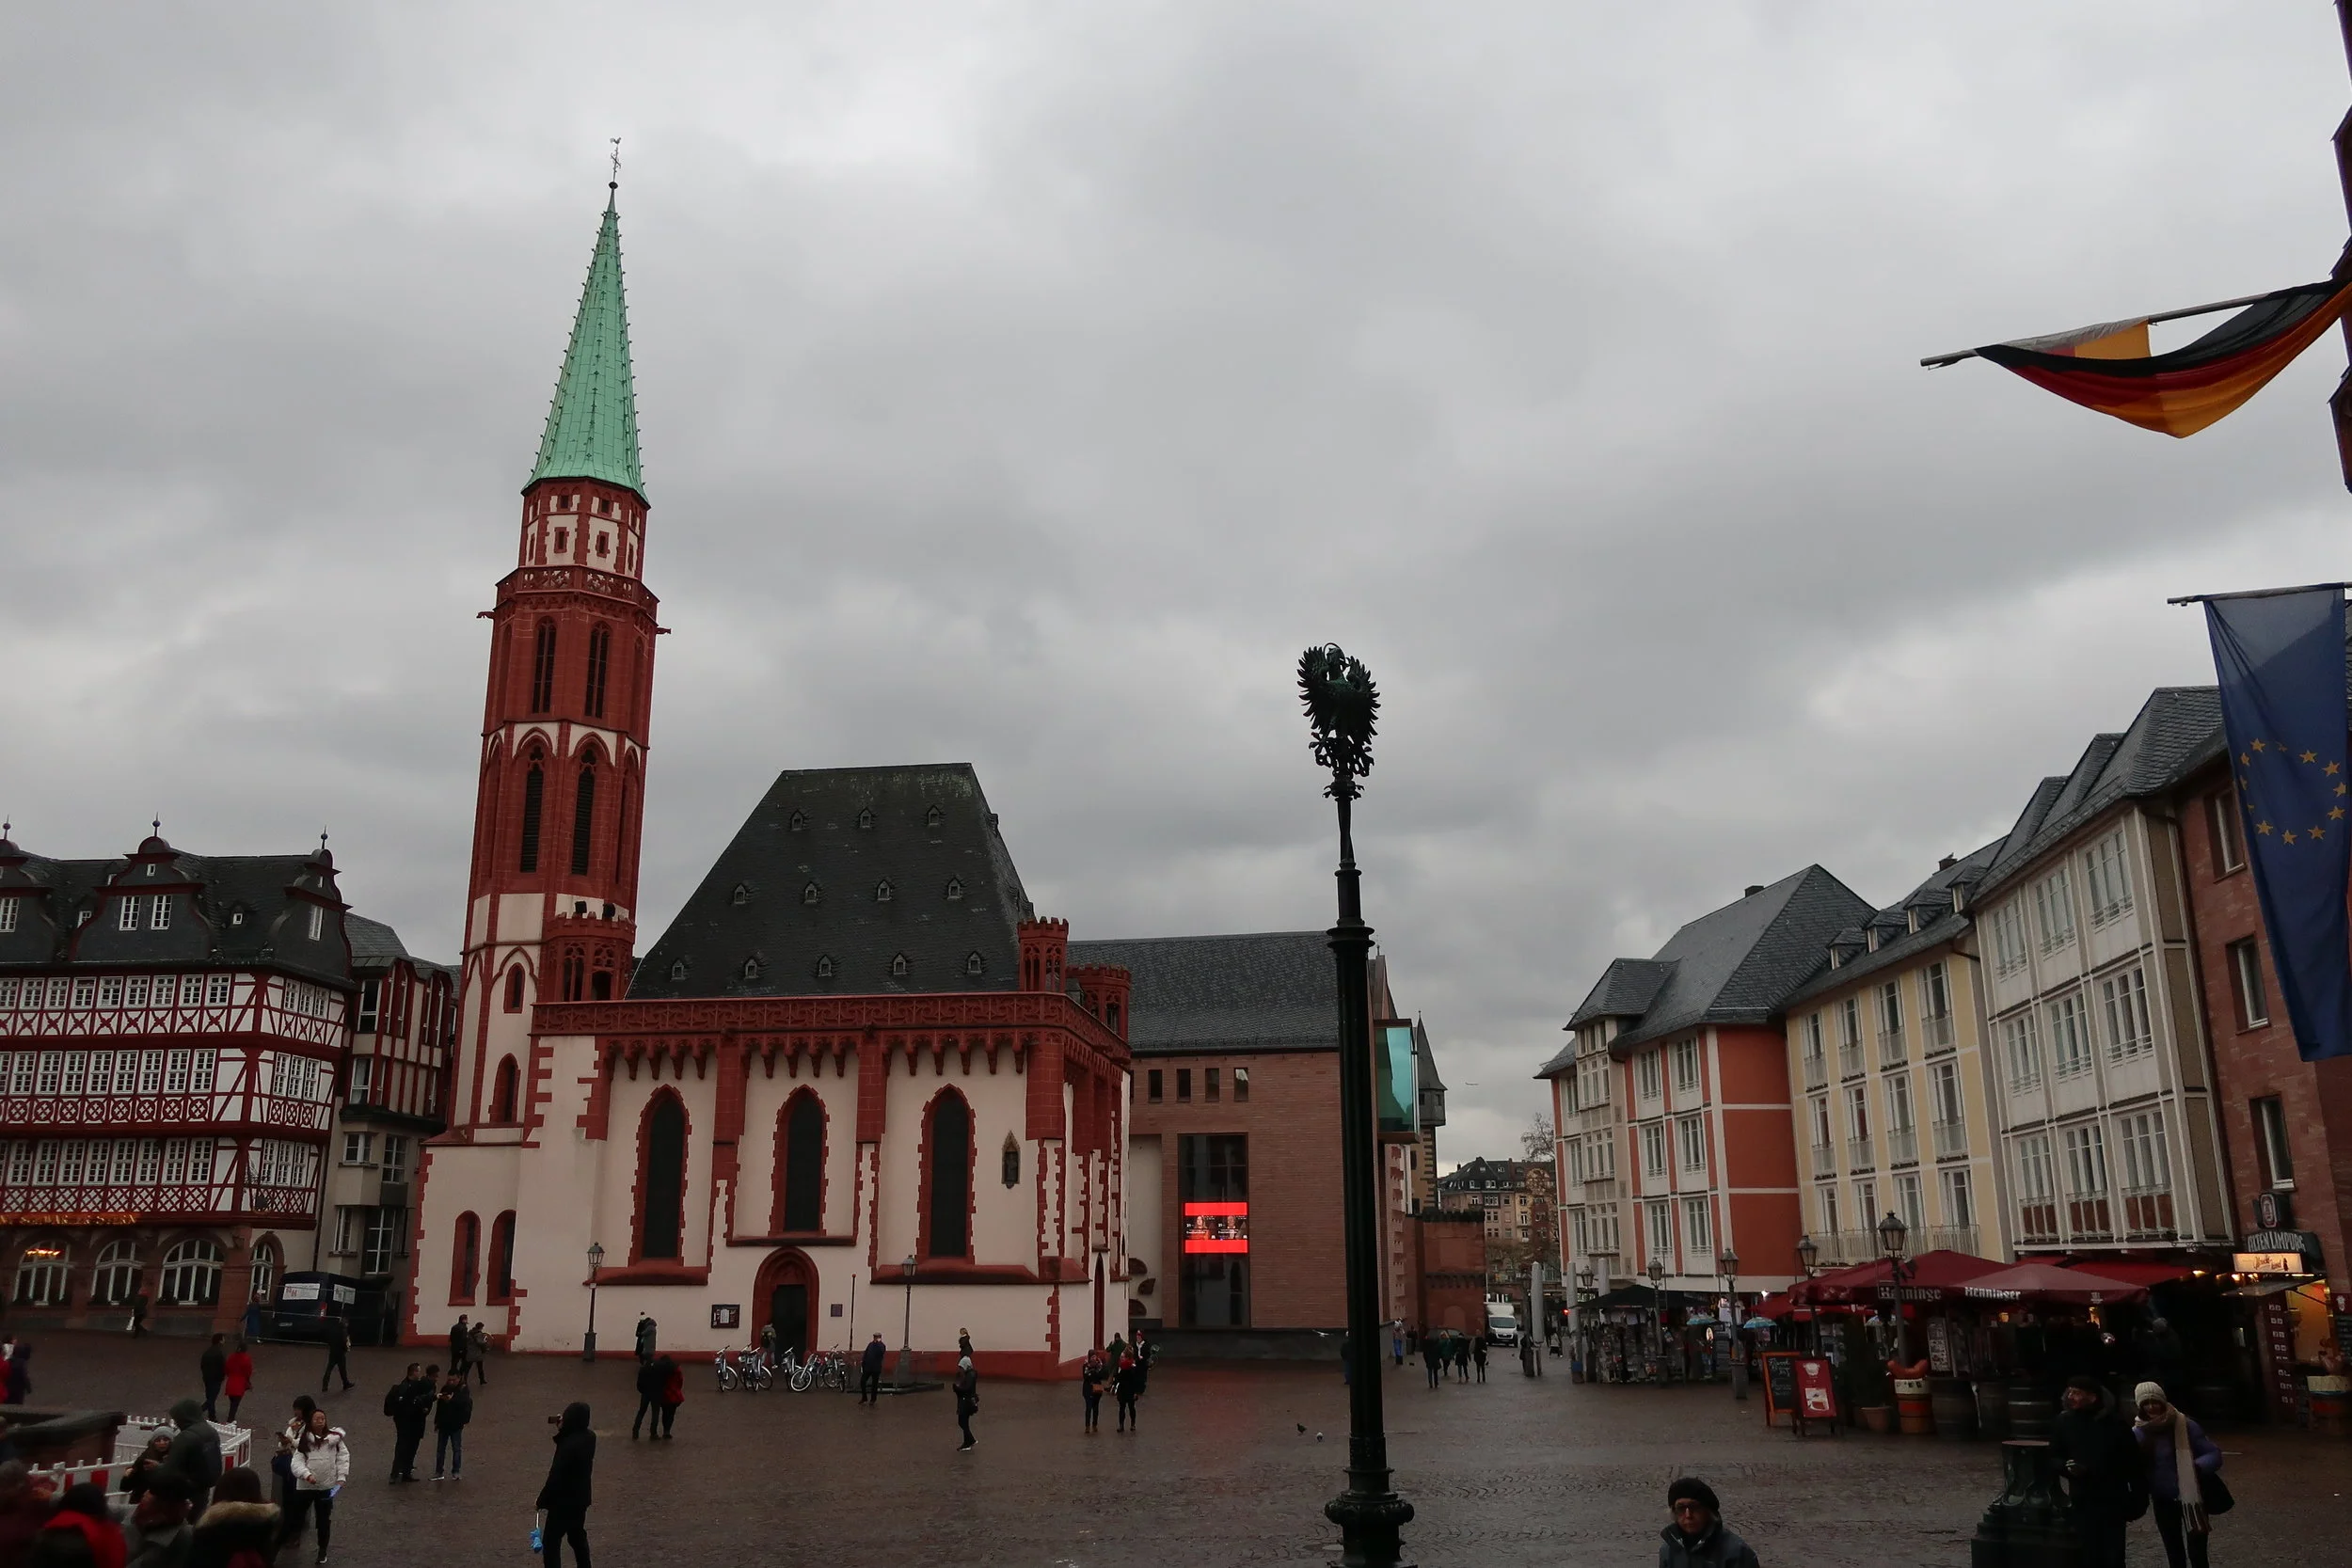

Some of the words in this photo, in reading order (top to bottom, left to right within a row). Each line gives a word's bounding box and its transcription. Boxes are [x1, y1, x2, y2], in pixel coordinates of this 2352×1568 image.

[2248, 1232, 2270, 1252] ALTEN
[2269, 1231, 2307, 1253] LIMPURG
[1964, 1286, 2022, 1302] Henninger
